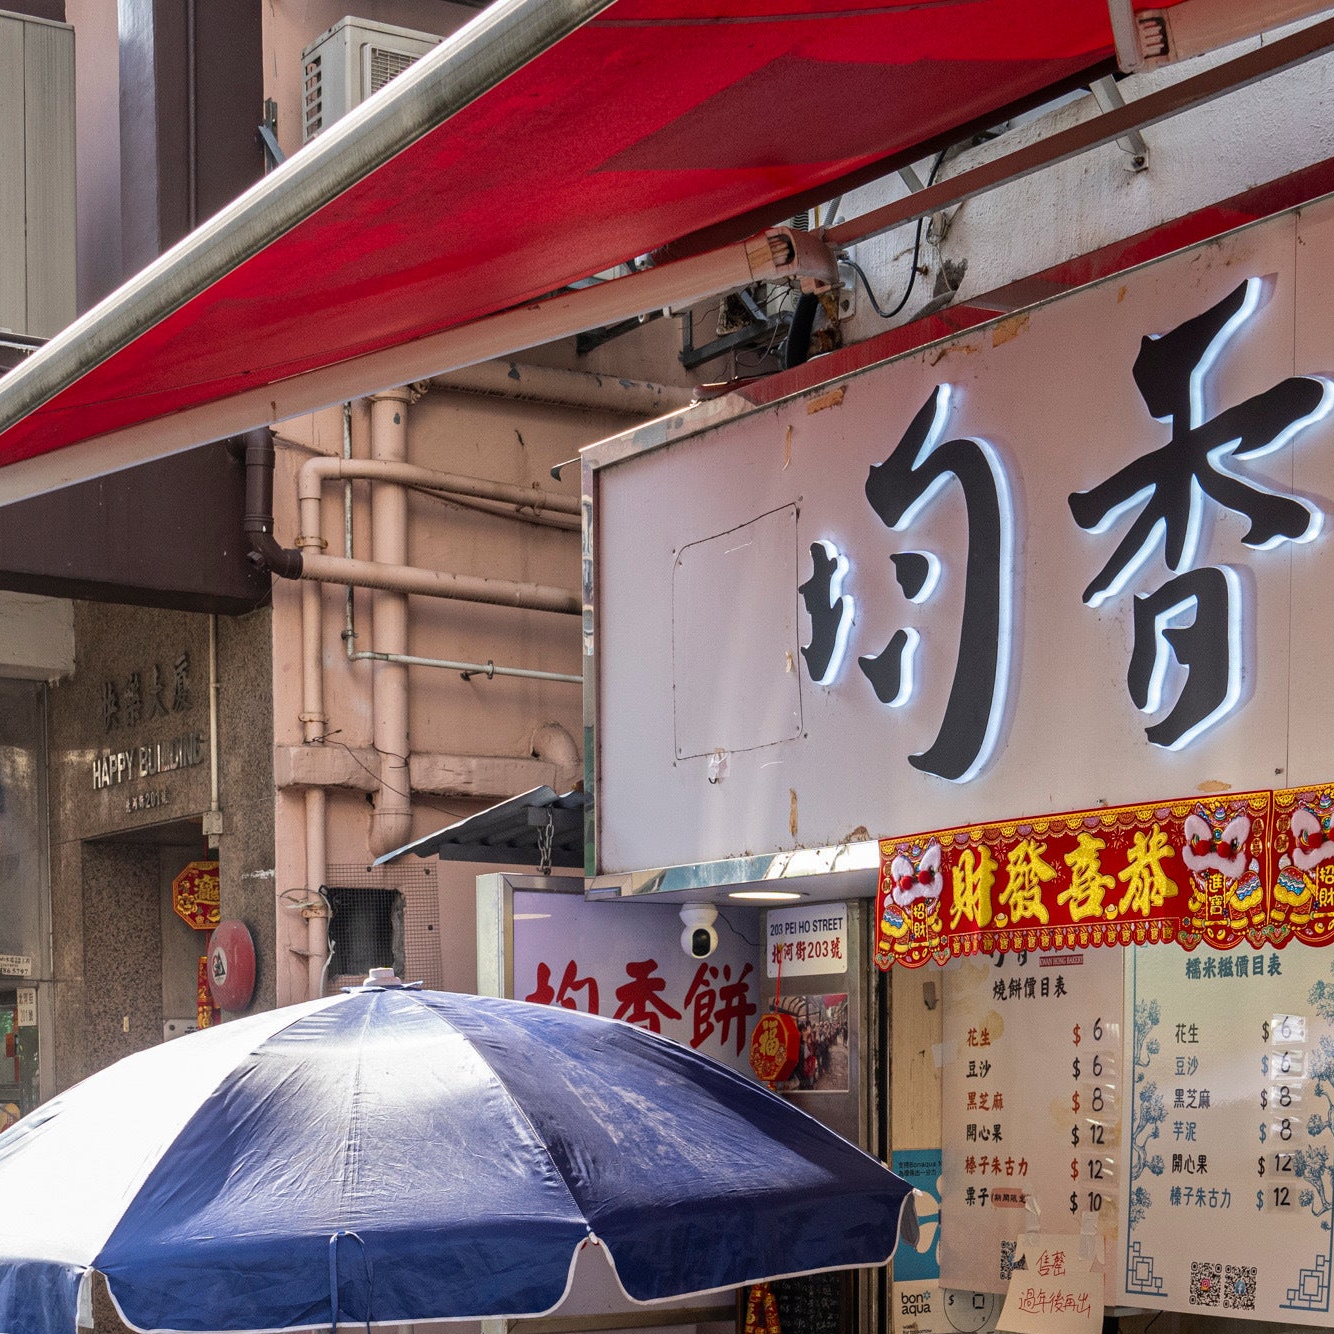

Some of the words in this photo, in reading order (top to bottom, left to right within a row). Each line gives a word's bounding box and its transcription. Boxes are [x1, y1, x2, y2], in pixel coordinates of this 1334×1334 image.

[102, 652, 193, 732] 快樂大廈
[92, 745, 135, 790] HAPPY
[138, 732, 203, 778] BUILDING
[770, 922, 783, 937] 203
[784, 921, 797, 935] PEI
[798, 920, 811, 934] HO
[812, 917, 844, 933] STREET
[912, 903, 927, 938] 招財
[770, 936, 843, 964] 北河街203號
[992, 975, 1068, 1000] 燒餅價目表
[967, 1027, 991, 1047] 花生
[1073, 1023, 1082, 1046] $
[1093, 1017, 1103, 1041] 6
[1175, 1022, 1199, 1044] 花生
[1262, 1020, 1270, 1043] $
[1281, 1015, 1291, 1039] 6
[966, 1059, 991, 1078] 豆沙
[1072, 1057, 1081, 1080] $
[1092, 1054, 1102, 1077] 6
[1174, 1055, 1199, 1077] 豆沙
[1261, 1055, 1269, 1076] $
[1280, 1051, 1291, 1073] 6
[966, 1091, 1004, 1111] 黑芝麻
[1072, 1091, 1081, 1114] $
[1092, 1087, 1104, 1112] 8
[1173, 1088, 1211, 1109] 黑芝麻
[1260, 1088, 1268, 1110] $
[1279, 1085, 1292, 1107] 8
[966, 1124, 1003, 1143] 開心果
[1071, 1124, 1080, 1147] $
[1090, 1124, 1105, 1145] 12
[1172, 1120, 1197, 1142] 芋泥
[1259, 1122, 1267, 1143] $
[1279, 1118, 1292, 1141] 8
[964, 1156, 1029, 1177] 榛子朱古力
[1070, 1158, 1079, 1180] $
[1088, 1159, 1104, 1180] 12
[1171, 1153, 1208, 1174] 開心果
[1257, 1156, 1266, 1177] $
[1274, 1154, 1292, 1173] 12
[1069, 1191, 1078, 1214] $
[1088, 1191, 1102, 1212] 10
[1169, 1186, 1231, 1209] 榛子朱古力
[1256, 1189, 1264, 1211] $
[1273, 1186, 1291, 1207] 12
[901, 1291, 924, 1304] bon
[1018, 1287, 1091, 1318] 過年後再出
[901, 1304, 932, 1317] aqua
